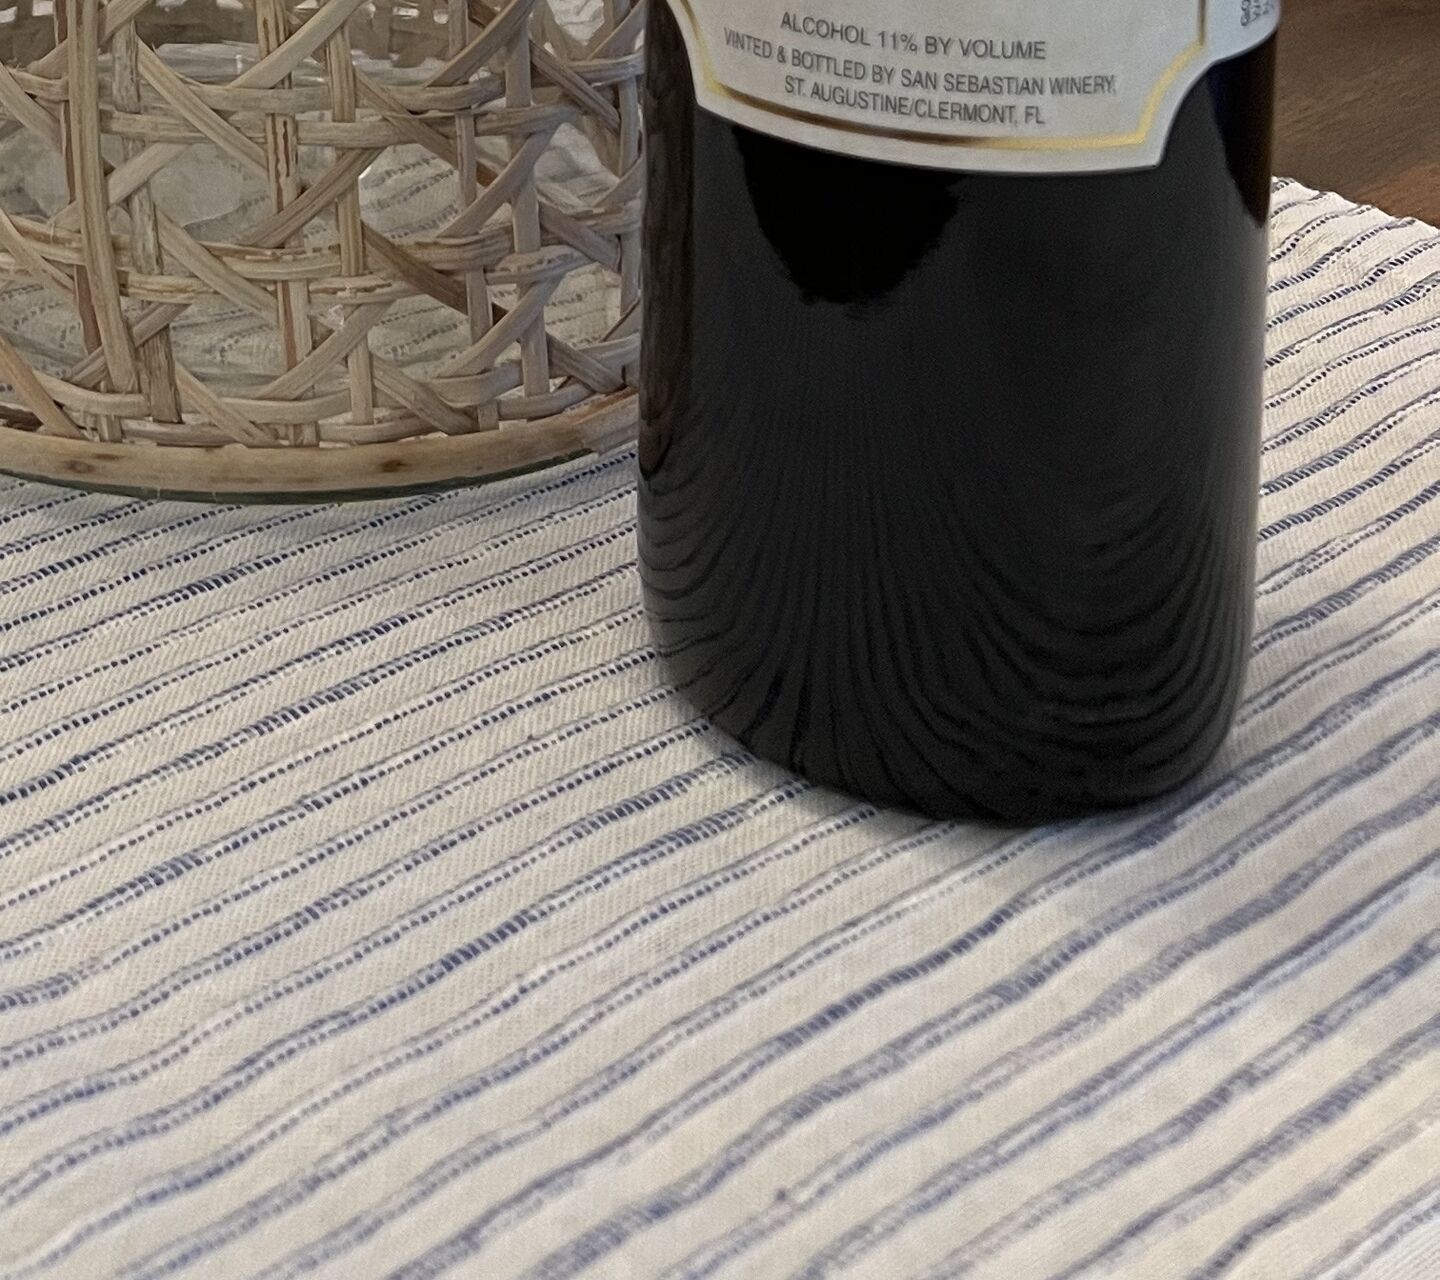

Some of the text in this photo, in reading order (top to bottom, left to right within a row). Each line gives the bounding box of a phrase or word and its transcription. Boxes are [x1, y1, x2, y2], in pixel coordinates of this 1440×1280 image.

[723, 26, 773, 59] VINTED
[776, 45, 787, 64] &
[791, 48, 867, 81] BOTTLED
[872, 64, 895, 86] BY
[901, 68, 938, 91] SAN
[943, 72, 1044, 96] SEBASTIAN
[780, 11, 1047, 61] ALCOHOL 11% BY VOLUME
[784, 74, 807, 97] ST.
[1024, 105, 1046, 125] FL
